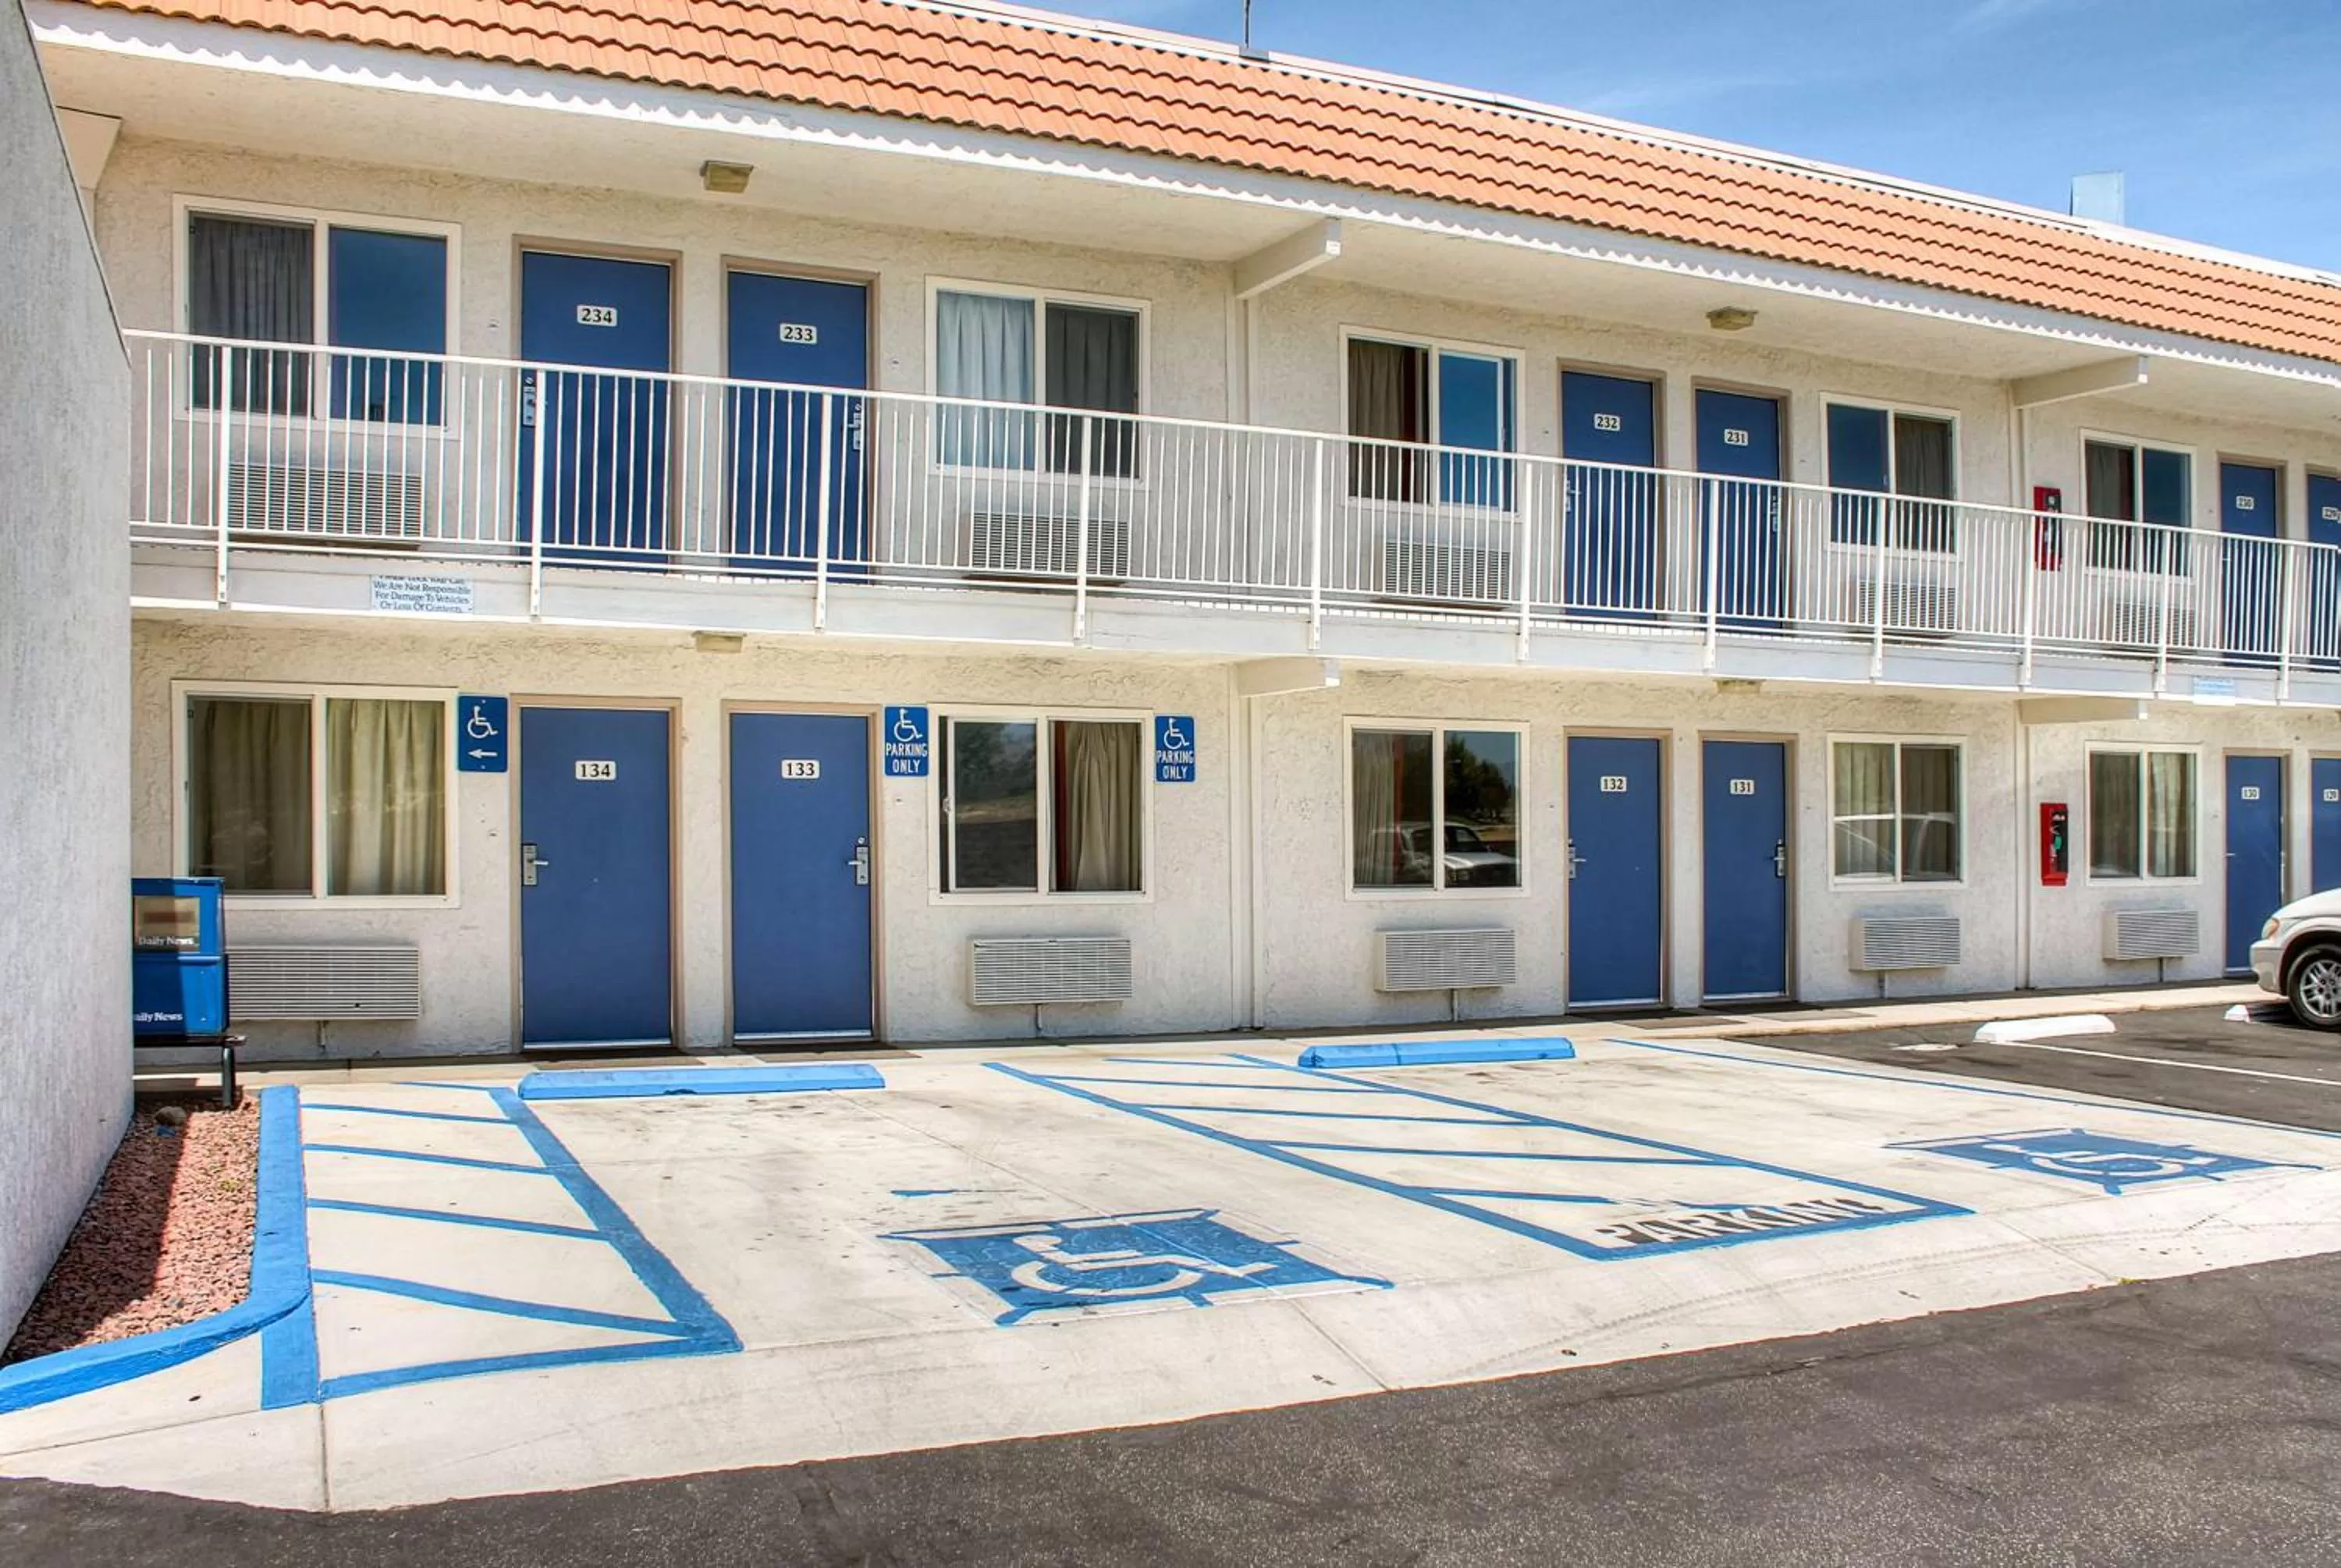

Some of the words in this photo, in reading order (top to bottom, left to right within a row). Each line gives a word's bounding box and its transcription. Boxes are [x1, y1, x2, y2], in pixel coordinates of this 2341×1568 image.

[581, 308, 613, 324] 234
[783, 326, 814, 342] 233
[1597, 416, 1618, 429] 232
[1727, 431, 1746, 444] 231
[404, 583, 421, 592] Not
[422, 583, 471, 595] Responsible
[375, 591, 389, 601] For
[886, 742, 928, 757] PARKING
[1156, 750, 1194, 764] PARKING
[580, 763, 611, 778] 134
[786, 762, 815, 777] 133
[892, 758, 921, 774] ONLY
[1162, 765, 1188, 779] ONLY
[1603, 778, 1625, 790] 132
[1733, 781, 1752, 793] 131
[139, 935, 165, 946] Daily
[166, 935, 194, 945] News
[133, 1012, 154, 1023] aily
[154, 1012, 183, 1021] News
